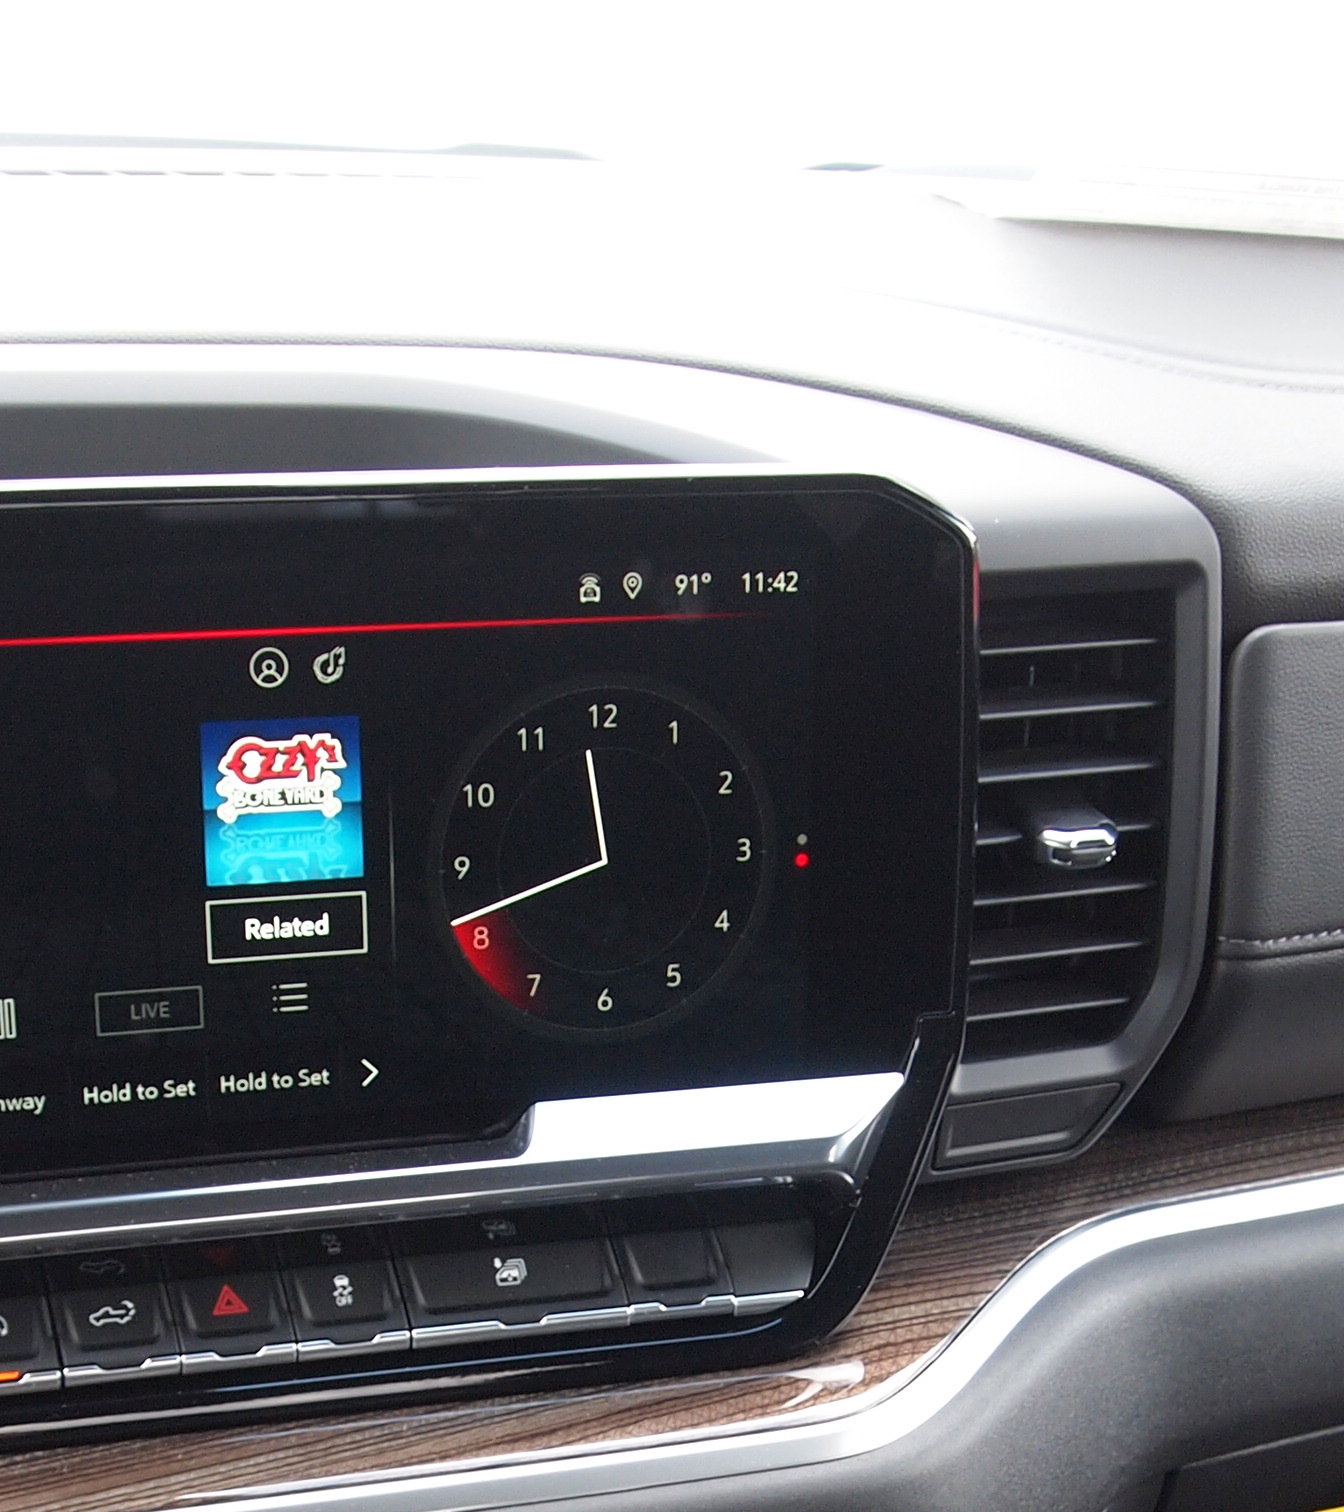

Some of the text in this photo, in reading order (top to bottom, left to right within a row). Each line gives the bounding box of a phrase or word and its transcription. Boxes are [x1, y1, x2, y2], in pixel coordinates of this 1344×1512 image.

[674, 571, 799, 595] 91° 11:42
[587, 703, 618, 729] 12
[516, 726, 545, 752] 11
[667, 720, 679, 745] 1
[717, 770, 733, 795] 2
[462, 783, 495, 808] 10
[735, 838, 751, 862] 3
[453, 855, 471, 880] 9
[244, 912, 330, 940] Related
[714, 910, 731, 932] 4
[472, 926, 490, 950] 8
[526, 973, 543, 997] 7
[665, 963, 682, 988] 5
[129, 1001, 172, 1021] LIVE
[596, 988, 614, 1012] 6
[82, 1079, 196, 1105] Hold to Set
[220, 1068, 331, 1094] Hold to Set
